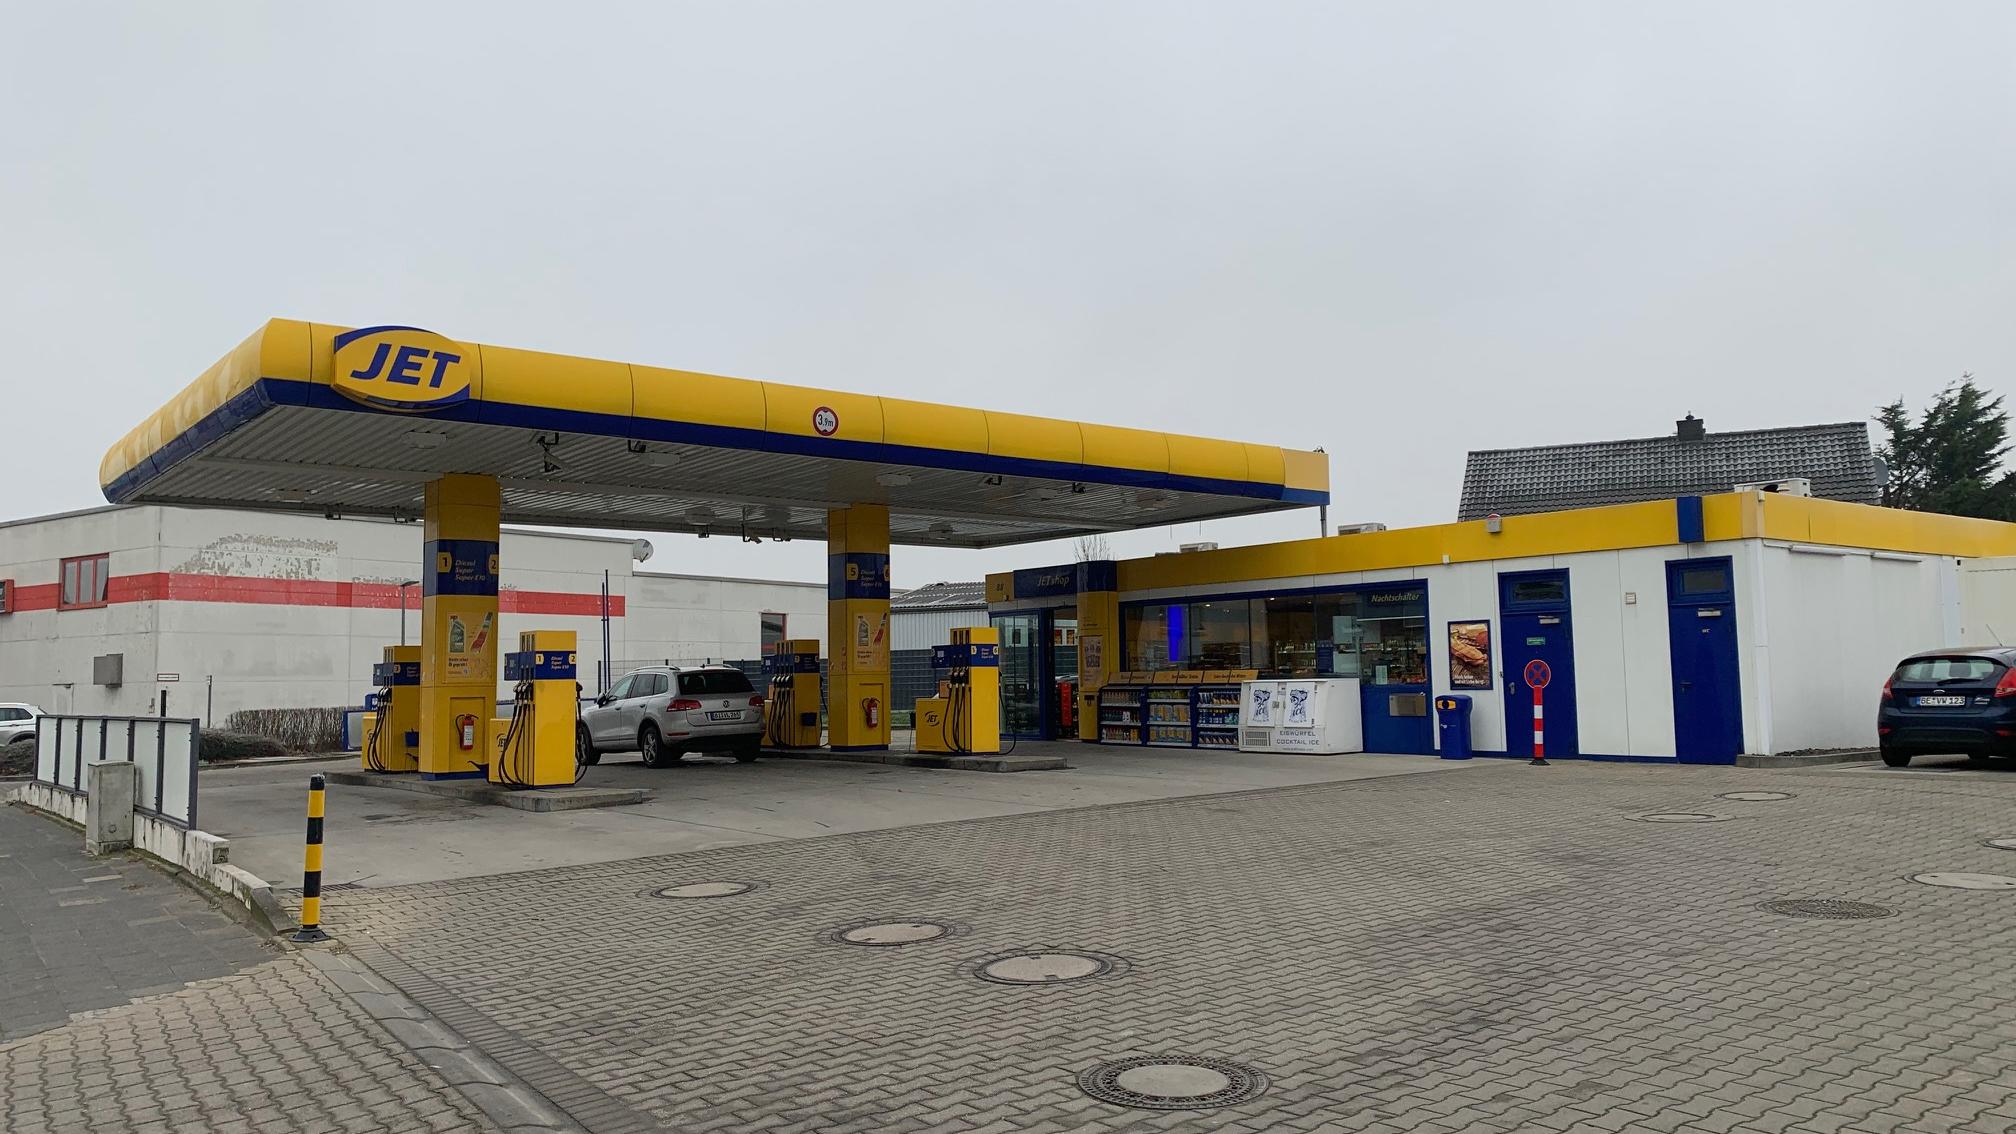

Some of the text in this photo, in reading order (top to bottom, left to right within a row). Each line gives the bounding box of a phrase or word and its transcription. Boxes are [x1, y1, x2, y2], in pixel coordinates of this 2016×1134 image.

[350, 343, 461, 389] JET
[442, 557, 448, 567] 1
[491, 560, 497, 570] 2
[851, 568, 857, 577] 5
[1371, 593, 1420, 602] Nachtschalter
